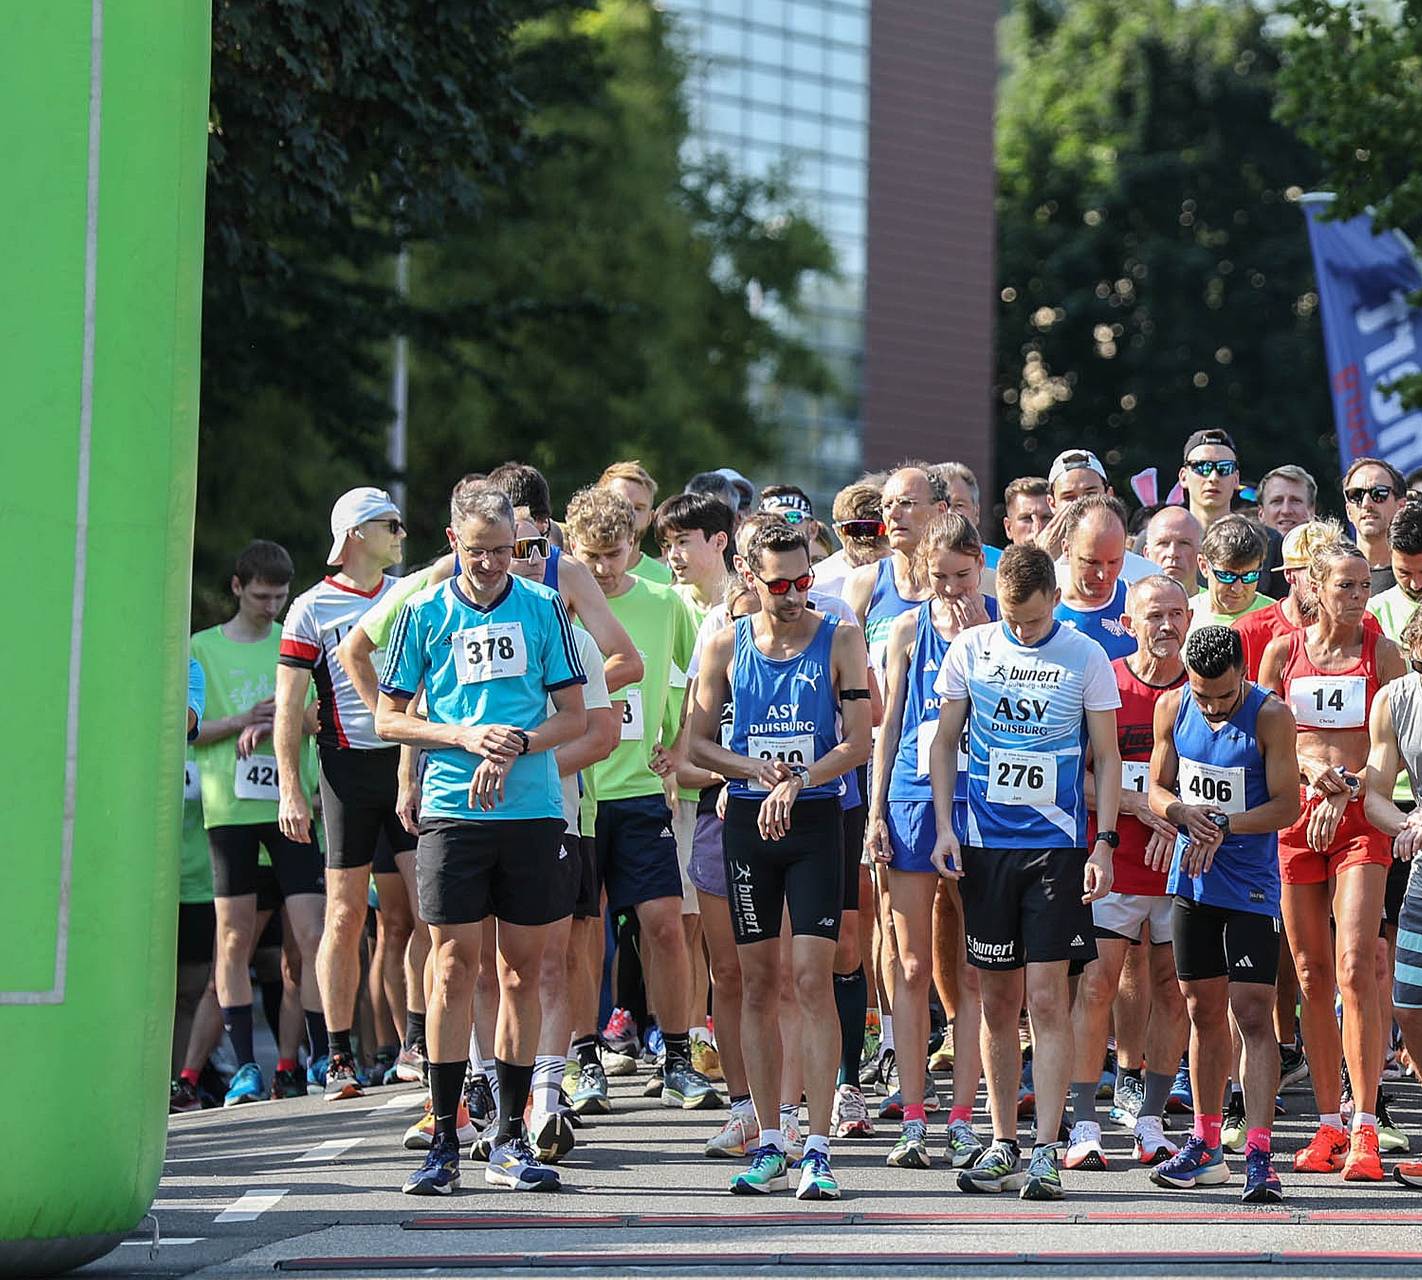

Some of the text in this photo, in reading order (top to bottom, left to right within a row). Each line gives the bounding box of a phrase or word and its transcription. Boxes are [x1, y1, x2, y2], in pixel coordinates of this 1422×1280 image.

[467, 637, 514, 664] 378
[1010, 666, 1060, 682] bunert
[993, 697, 1050, 722] ASV
[1313, 688, 1344, 711] 14
[749, 721, 815, 735] DUISBURG
[991, 723, 1048, 736] DUISBURG
[997, 762, 1044, 789] 276
[1189, 775, 1232, 802] 406
[738, 884, 763, 934] bunert
[972, 937, 1014, 956] bunert
